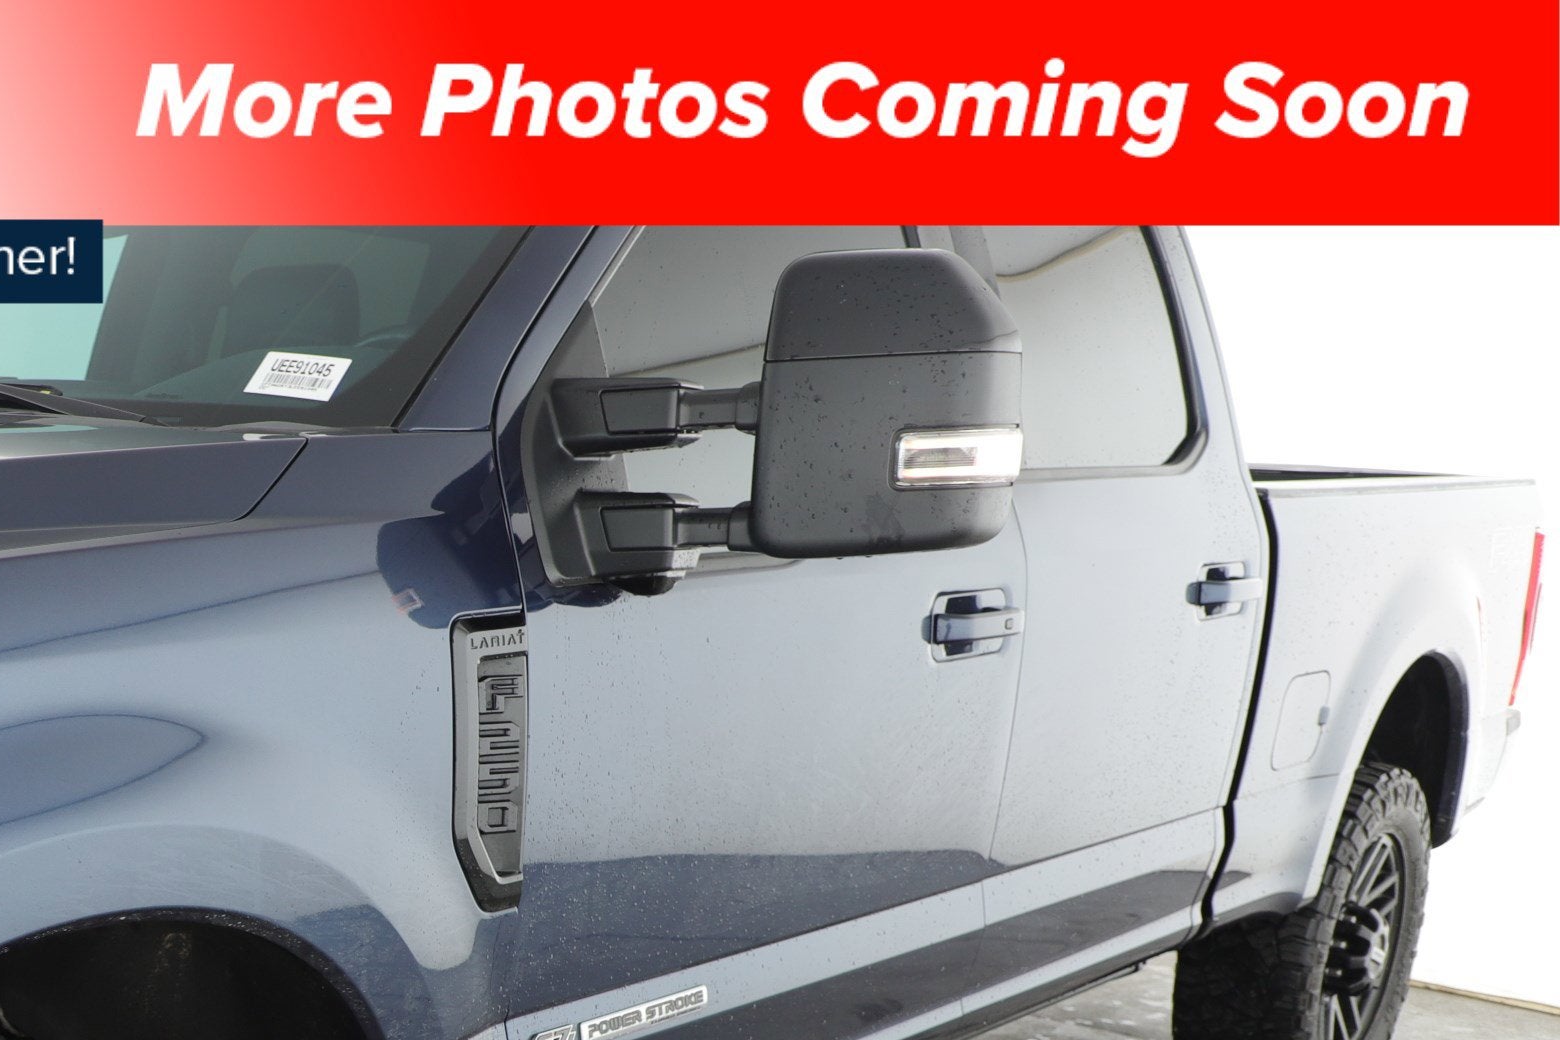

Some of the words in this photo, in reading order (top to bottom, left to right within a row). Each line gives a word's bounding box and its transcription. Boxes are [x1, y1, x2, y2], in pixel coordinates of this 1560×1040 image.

[271, 359, 336, 377] UEE91045
[470, 629, 525, 650] LARIAT
[588, 1009, 642, 1040] POWER
[645, 990, 705, 1021] STROKE
